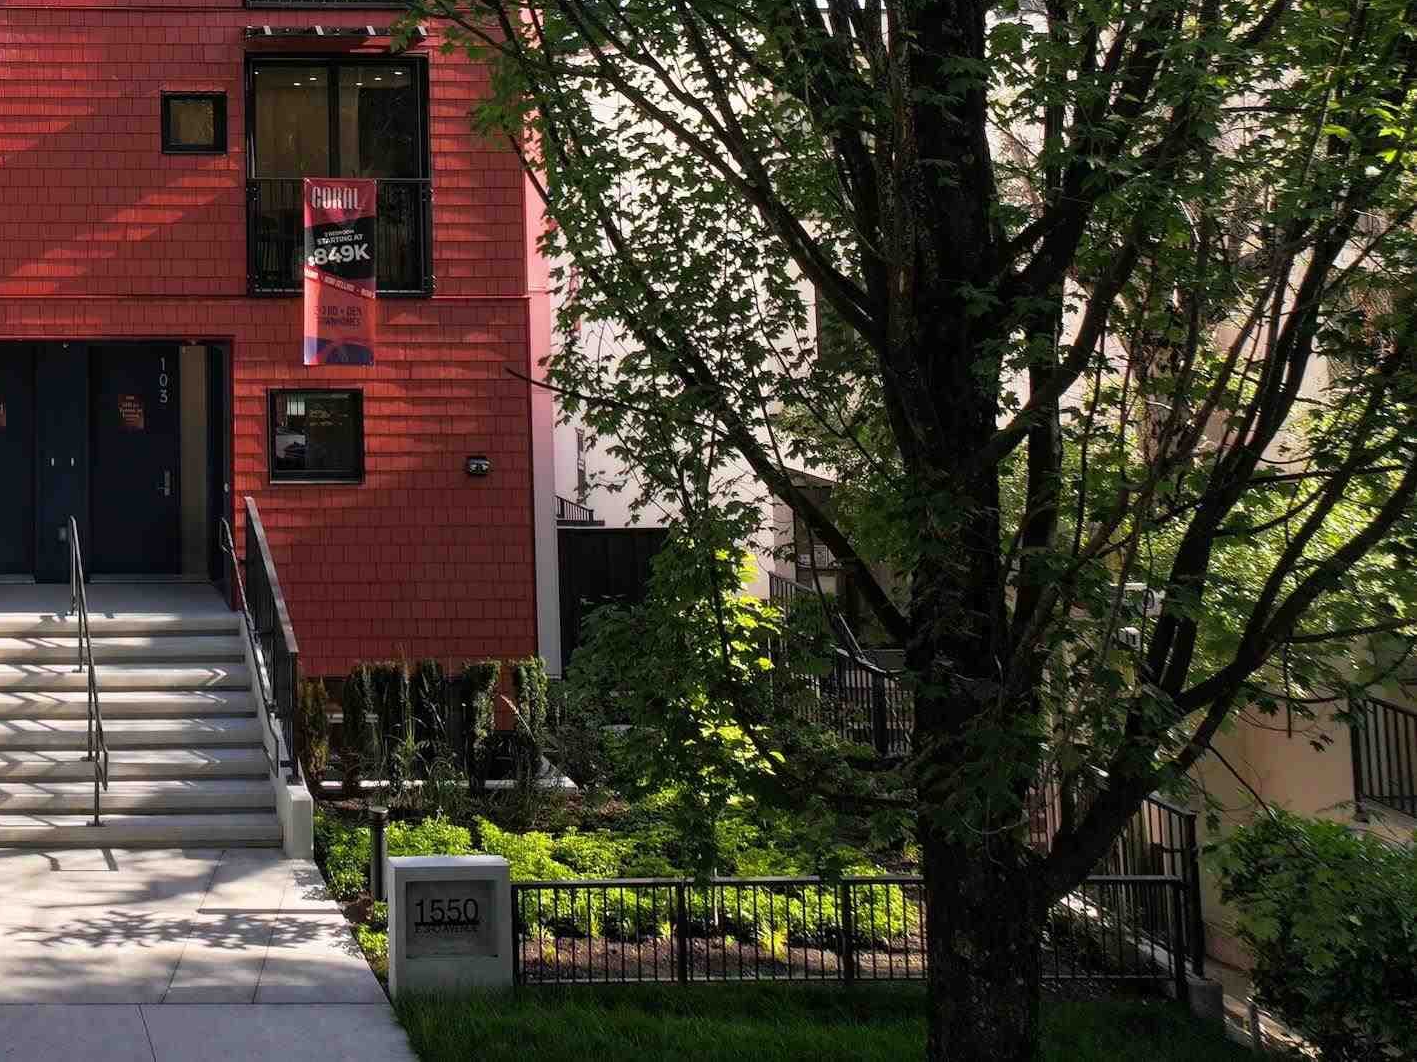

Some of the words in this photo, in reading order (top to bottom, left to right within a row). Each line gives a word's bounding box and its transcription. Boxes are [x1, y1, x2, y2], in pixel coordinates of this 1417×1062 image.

[311, 186, 361, 210] CORAL
[316, 235, 353, 245] STARTING
[353, 233, 364, 241] AT
[308, 243, 371, 266] $849K
[159, 357, 168, 403] 103
[415, 898, 479, 923] 1550
